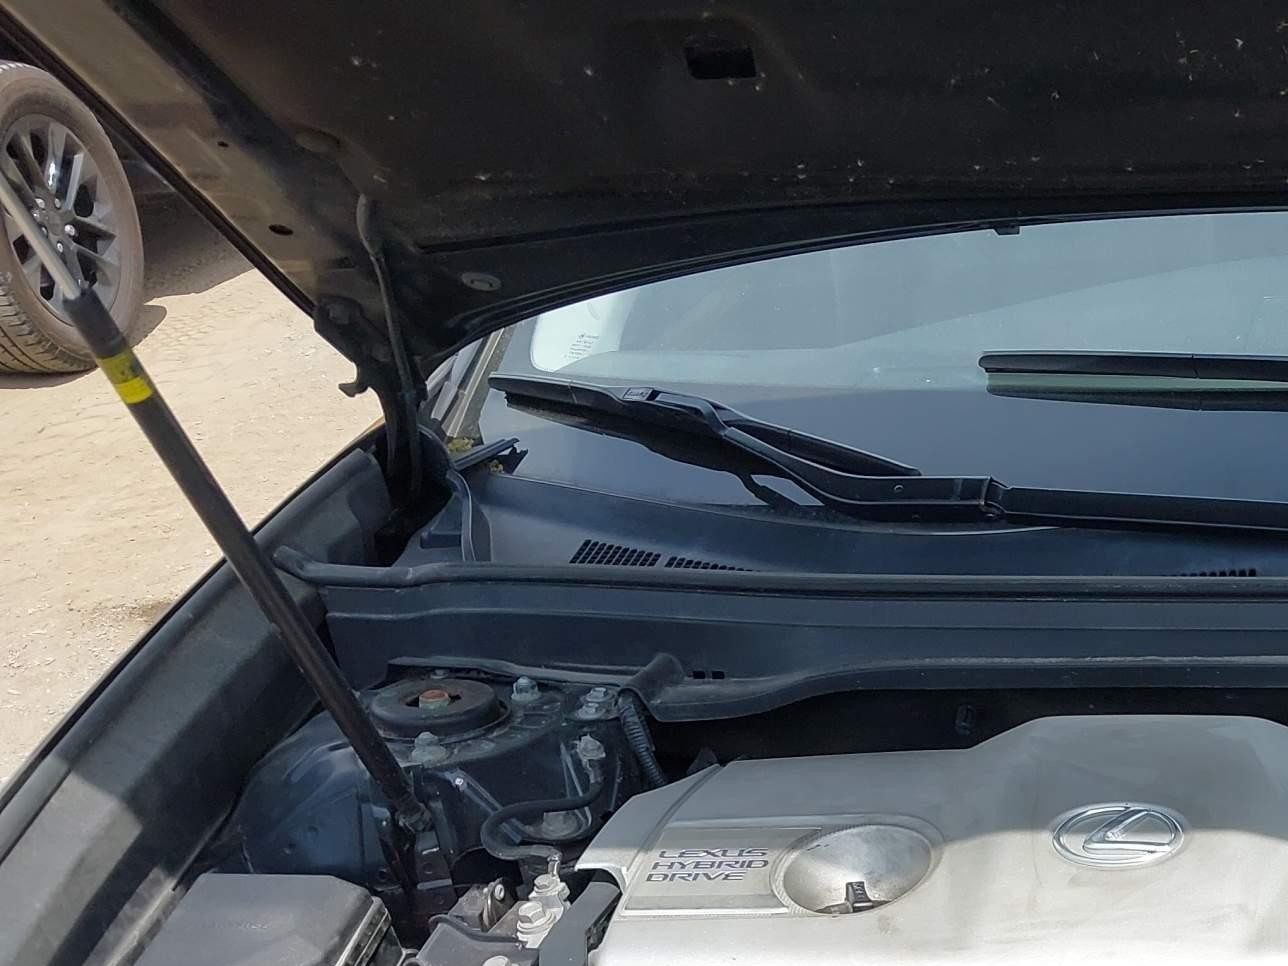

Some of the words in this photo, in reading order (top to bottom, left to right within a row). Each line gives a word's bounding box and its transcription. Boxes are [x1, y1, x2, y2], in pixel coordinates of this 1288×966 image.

[658, 848, 769, 858] LEXUS
[652, 860, 769, 870] HYBRID
[645, 871, 747, 881] DRIVE
